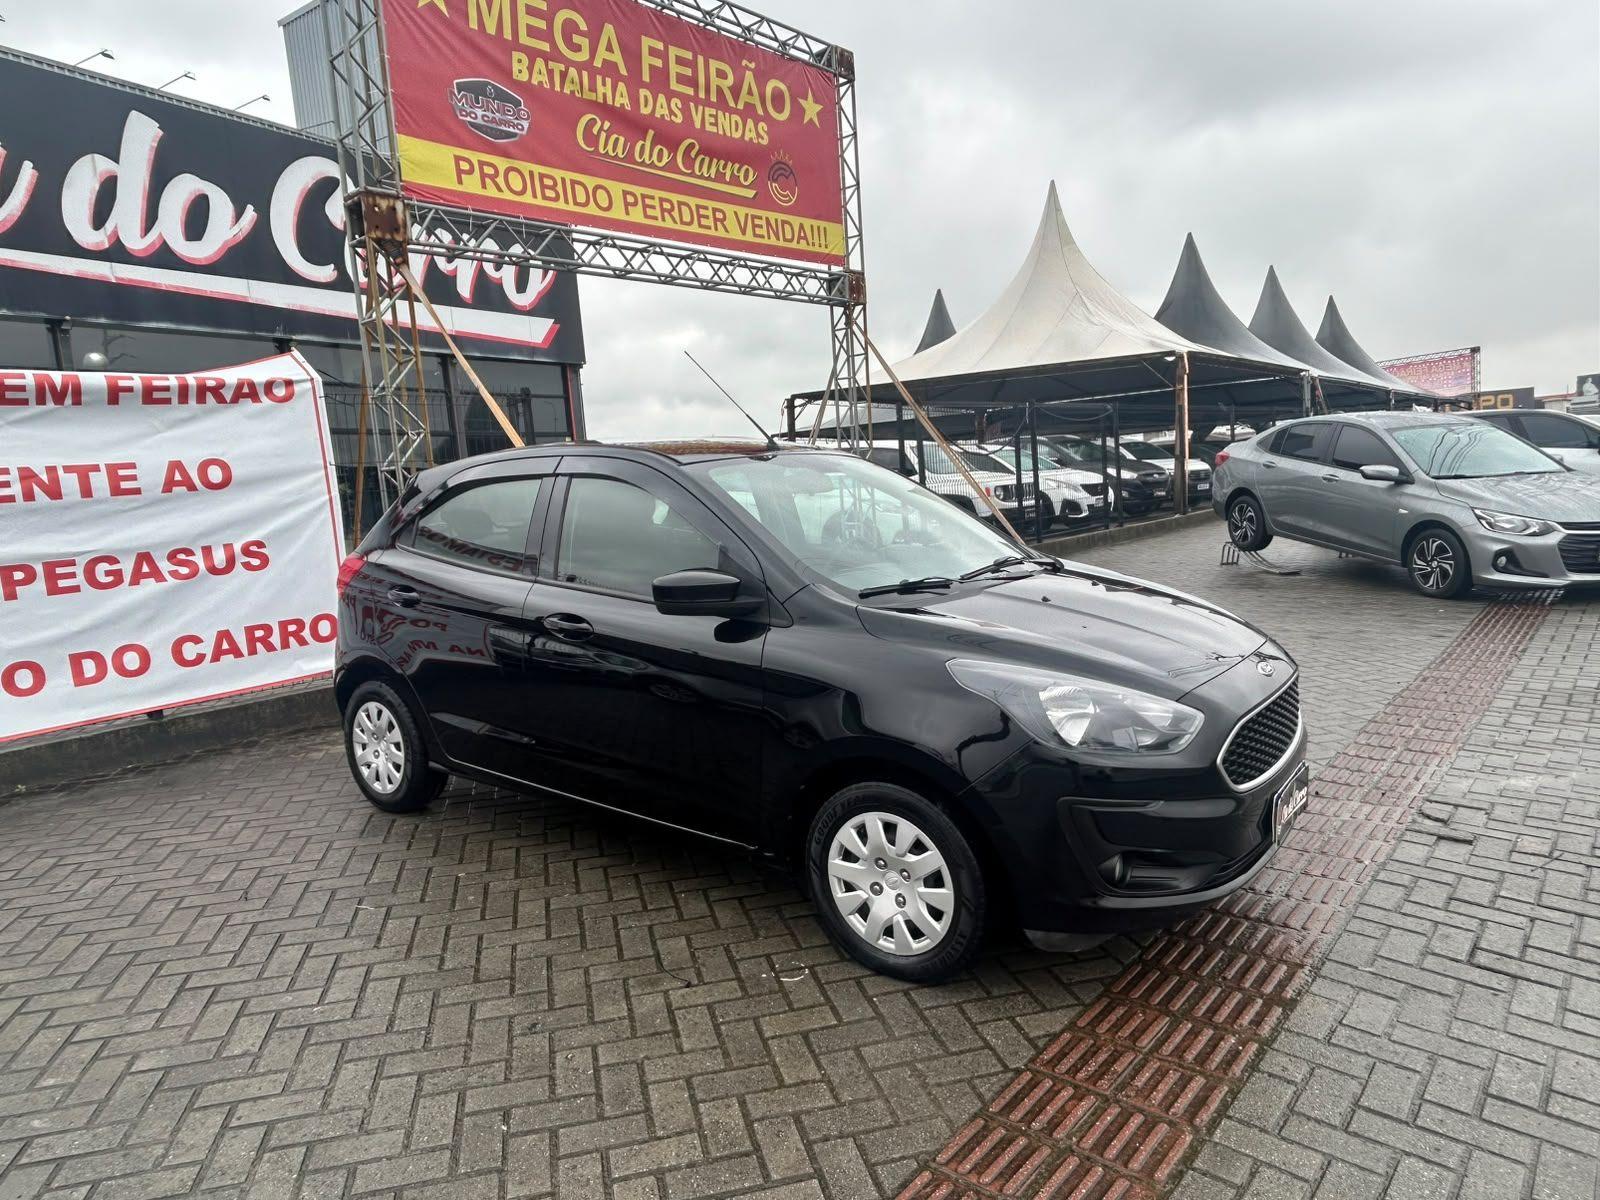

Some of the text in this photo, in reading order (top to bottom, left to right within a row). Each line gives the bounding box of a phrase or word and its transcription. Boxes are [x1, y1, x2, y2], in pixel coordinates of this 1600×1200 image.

[466, 0, 791, 122] MEGA FEIRÃO
[447, 87, 531, 121] MUNDO
[459, 107, 478, 121] DO
[481, 114, 525, 132] CARRO
[511, 51, 770, 146] BATALHA DAS VENDAS
[575, 112, 758, 187] Cia do Carro
[61, 110, 258, 266] do
[453, 153, 829, 250] PROIBIDO PERDER VENDA!!!
[0, 372, 296, 406] EM FEIRAO
[160, 457, 233, 494] AO
[0, 539, 270, 601] PEGASUS
[68, 643, 152, 687] DO
[170, 613, 338, 668] CARRO
